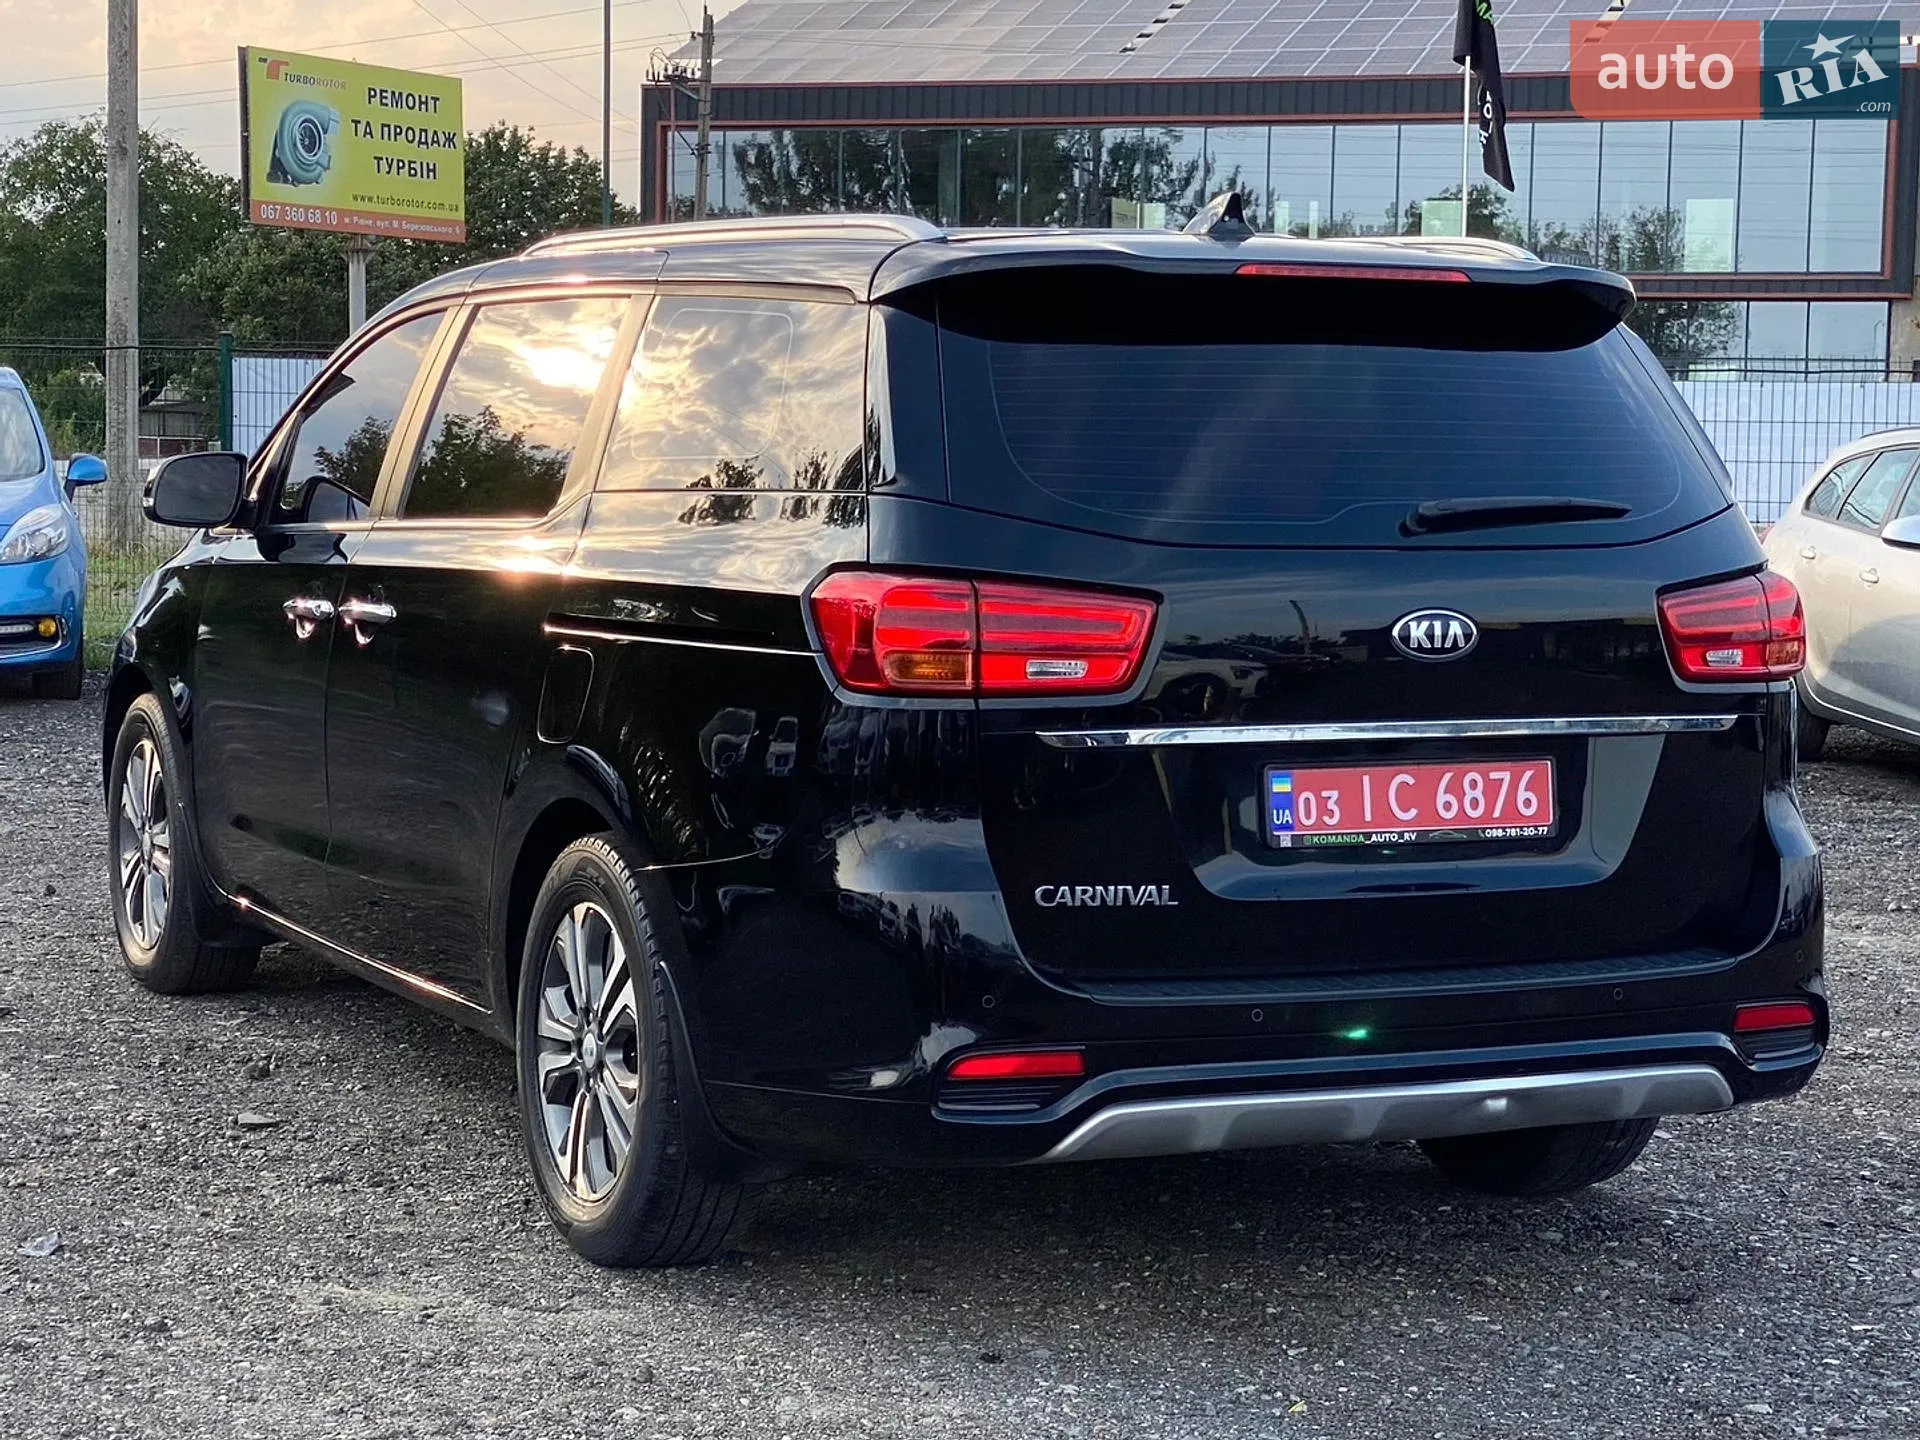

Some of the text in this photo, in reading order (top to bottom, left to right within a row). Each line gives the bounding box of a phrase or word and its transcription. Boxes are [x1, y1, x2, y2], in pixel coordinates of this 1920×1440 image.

[284, 72, 348, 90] TURBOROTOR
[367, 86, 440, 114] РЕМОНТ
[351, 118, 458, 150] ТА ПРОДАЖ
[373, 155, 438, 180] ТУРБІН
[352, 193, 460, 212] www.turborotor.com.ua
[261, 204, 338, 225] 067 360 68 10
[1408, 620, 1466, 648] KIA
[1298, 790, 1341, 826] 03
[1435, 770, 1538, 820] 6876
[1273, 808, 1292, 825] UA
[1311, 826, 1548, 845] KOMANDA_AUTO_RV 098-781-20-77
[1034, 885, 1179, 907] CARNIVAL
